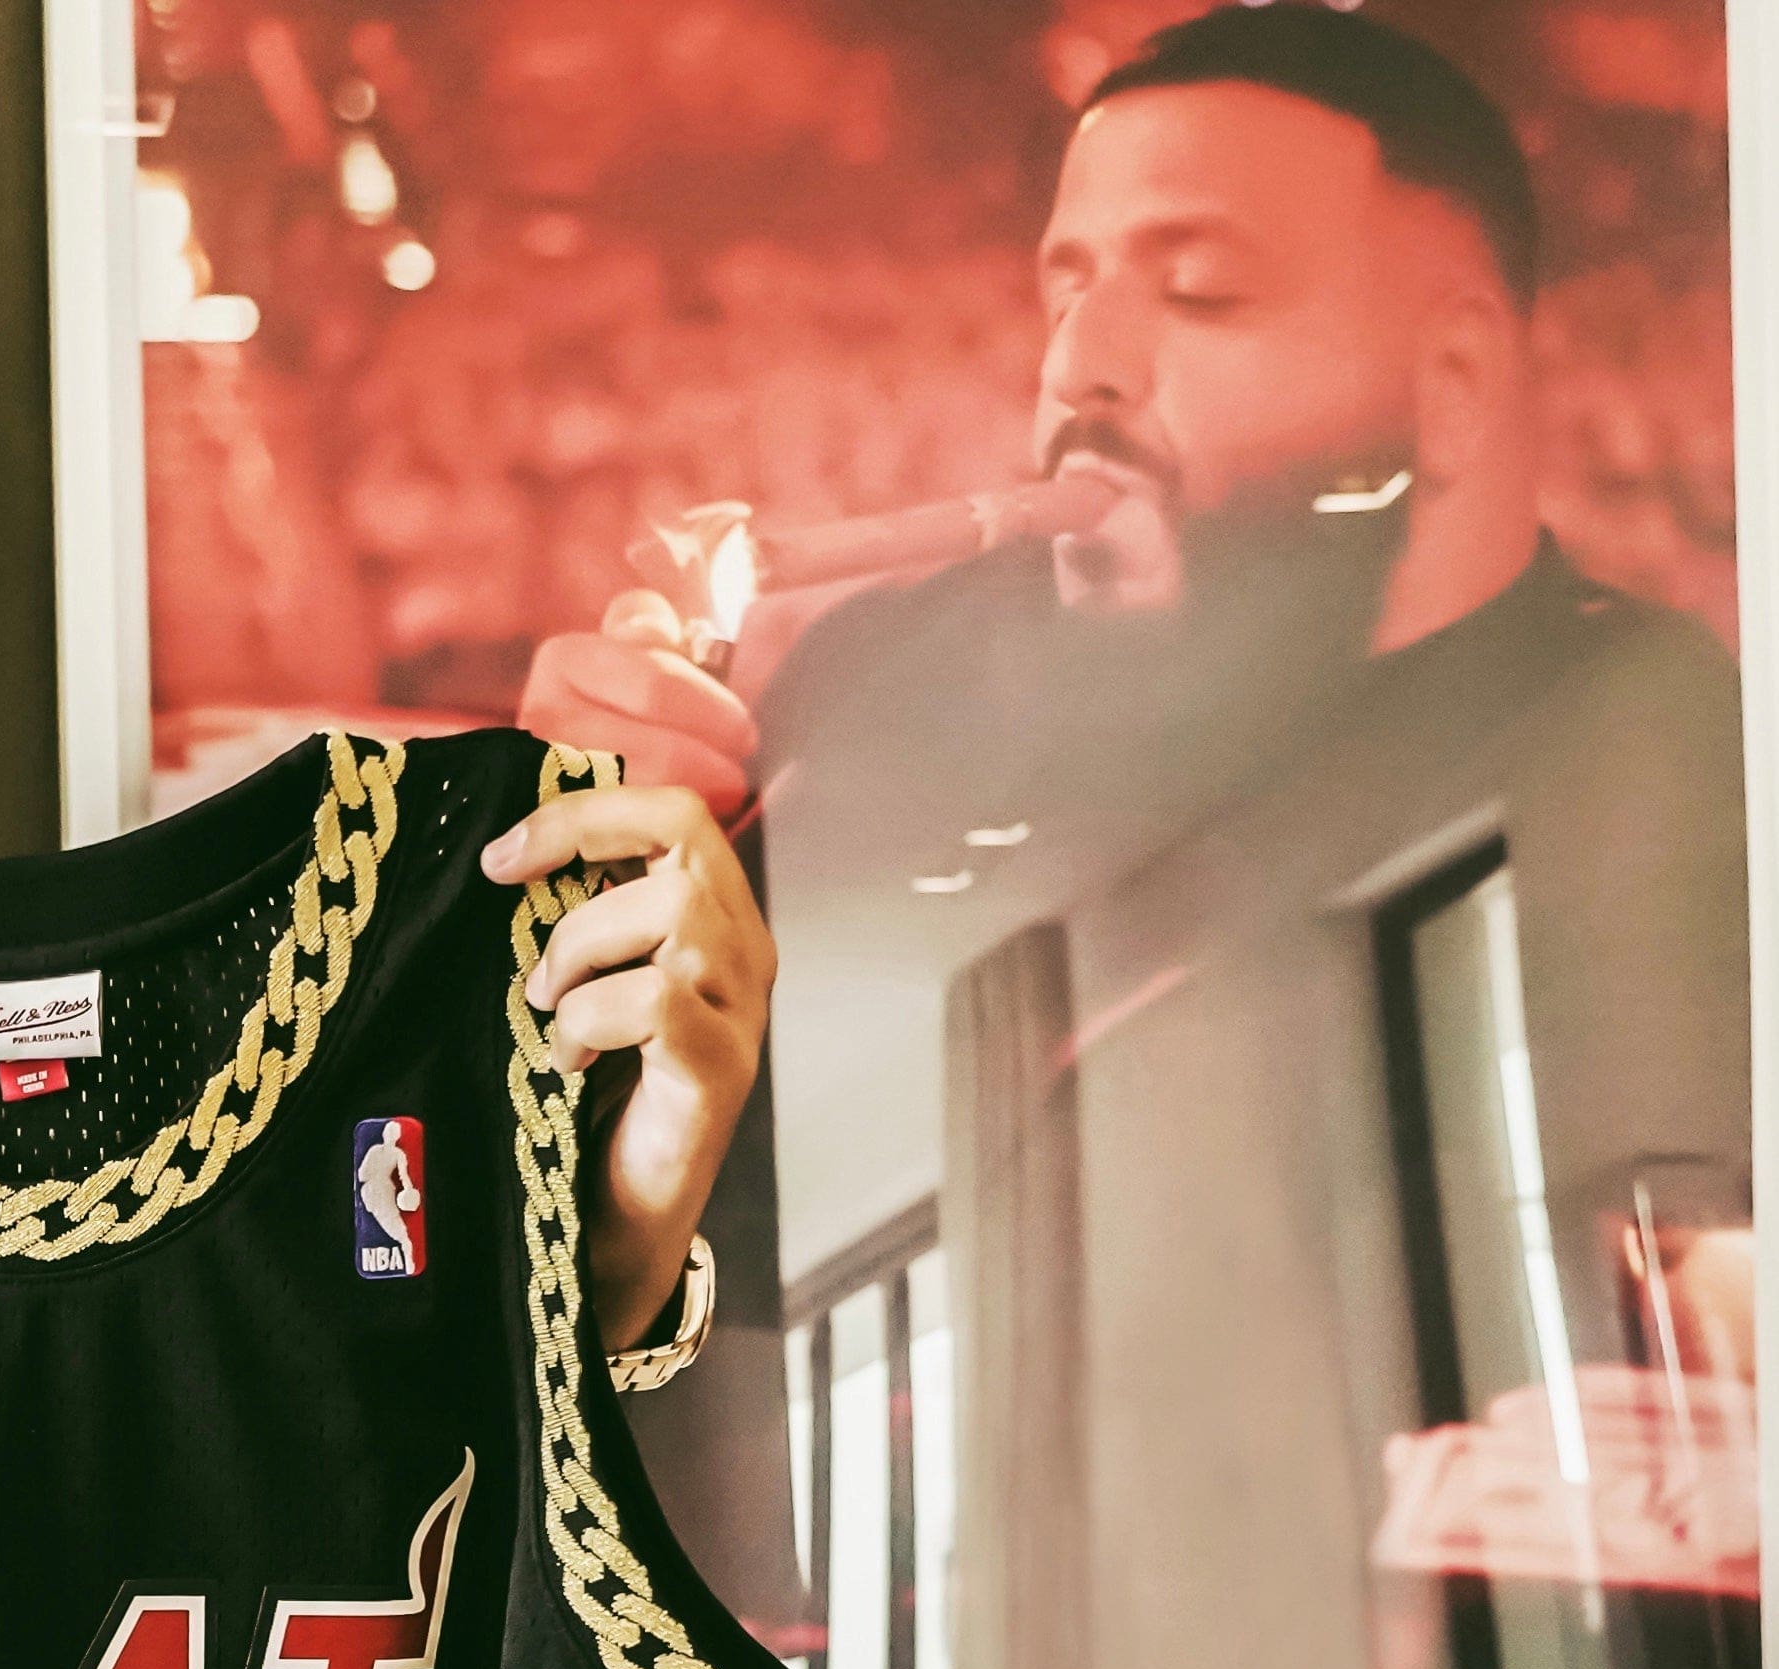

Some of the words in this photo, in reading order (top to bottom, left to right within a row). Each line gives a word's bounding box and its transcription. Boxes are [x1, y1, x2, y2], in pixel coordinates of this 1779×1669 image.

[25, 1008, 41, 1023] &
[43, 996, 93, 1019] Ness
[12, 1031, 79, 1045] PHILADELPHIA,
[361, 1246, 404, 1272] NBA
